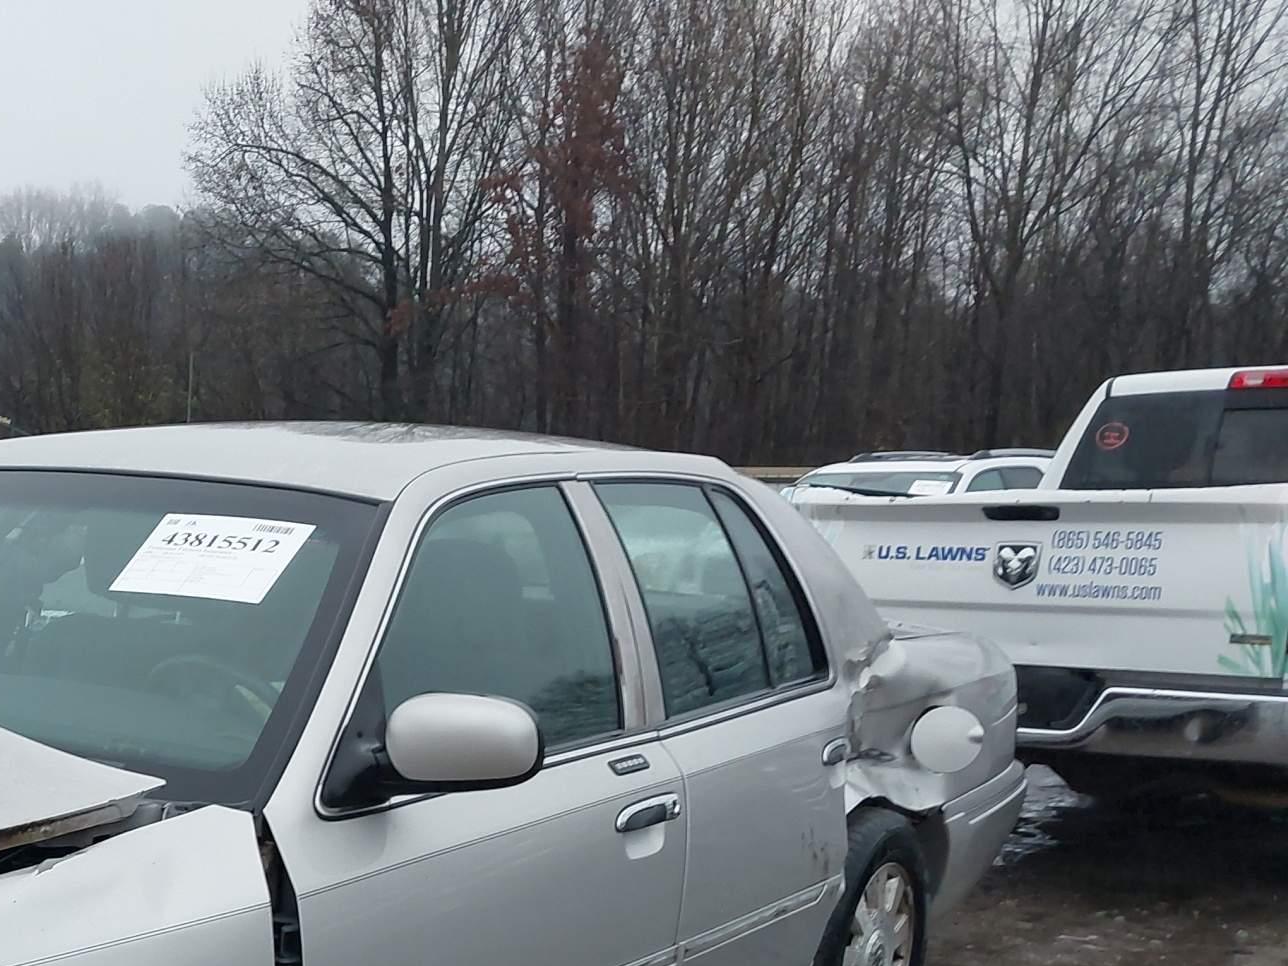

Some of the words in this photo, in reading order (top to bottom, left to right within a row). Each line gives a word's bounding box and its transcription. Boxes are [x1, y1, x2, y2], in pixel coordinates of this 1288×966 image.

[162, 532, 280, 553] 43815512
[1052, 530, 1090, 549] (865)
[1092, 531, 1163, 550] 546-5845
[878, 545, 911, 560] U.S.
[915, 546, 990, 561] LAWNS
[1047, 555, 1086, 575] (423)
[1087, 556, 1158, 576] 473-0065
[1036, 581, 1162, 600] www.uslawns.com
